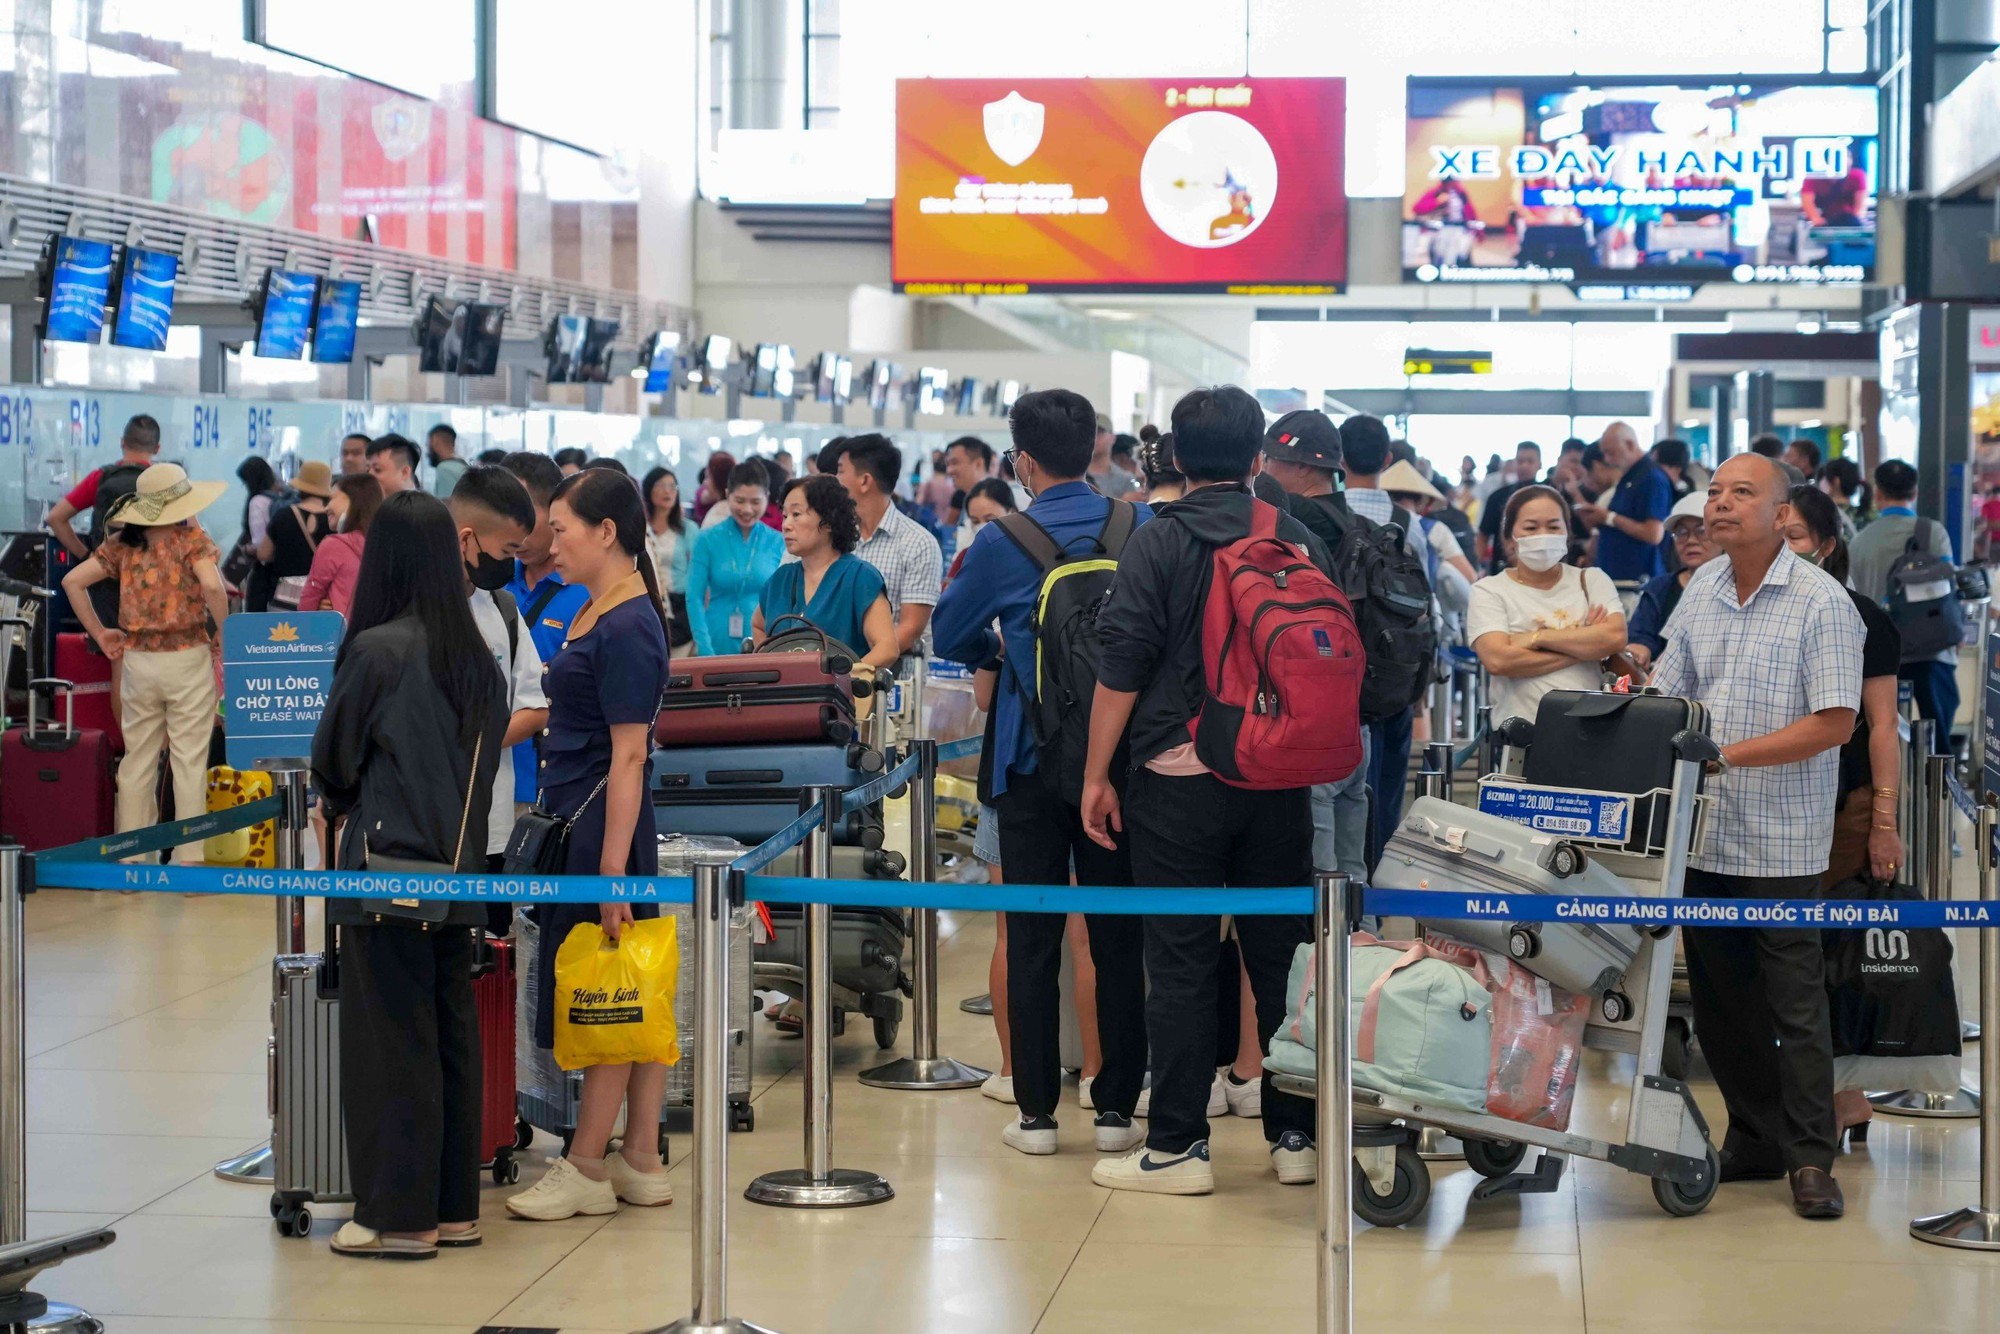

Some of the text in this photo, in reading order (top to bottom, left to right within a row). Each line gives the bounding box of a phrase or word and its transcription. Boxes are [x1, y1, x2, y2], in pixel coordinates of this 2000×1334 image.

[1433, 146, 1499, 178] XE
[194, 405, 219, 447] B14
[246, 675, 319, 690] VUI LÒNG
[236, 693, 329, 710] CHỜ TẠI ĐÂ
[250, 711, 322, 722] PLEASE WAIT
[1486, 791, 1516, 803] BIZMAN
[1525, 795, 1554, 811] 20.000
[125, 870, 170, 885] N.I.A
[612, 882, 657, 897] N.I.A
[1466, 898, 1989, 925] N.I.A CẢNG HÀNG KHÔNG QUỐC TẾ NỘI BÀI N.I.A
[1861, 963, 1919, 973] insidemen
[610, 987, 639, 1004] Linh
